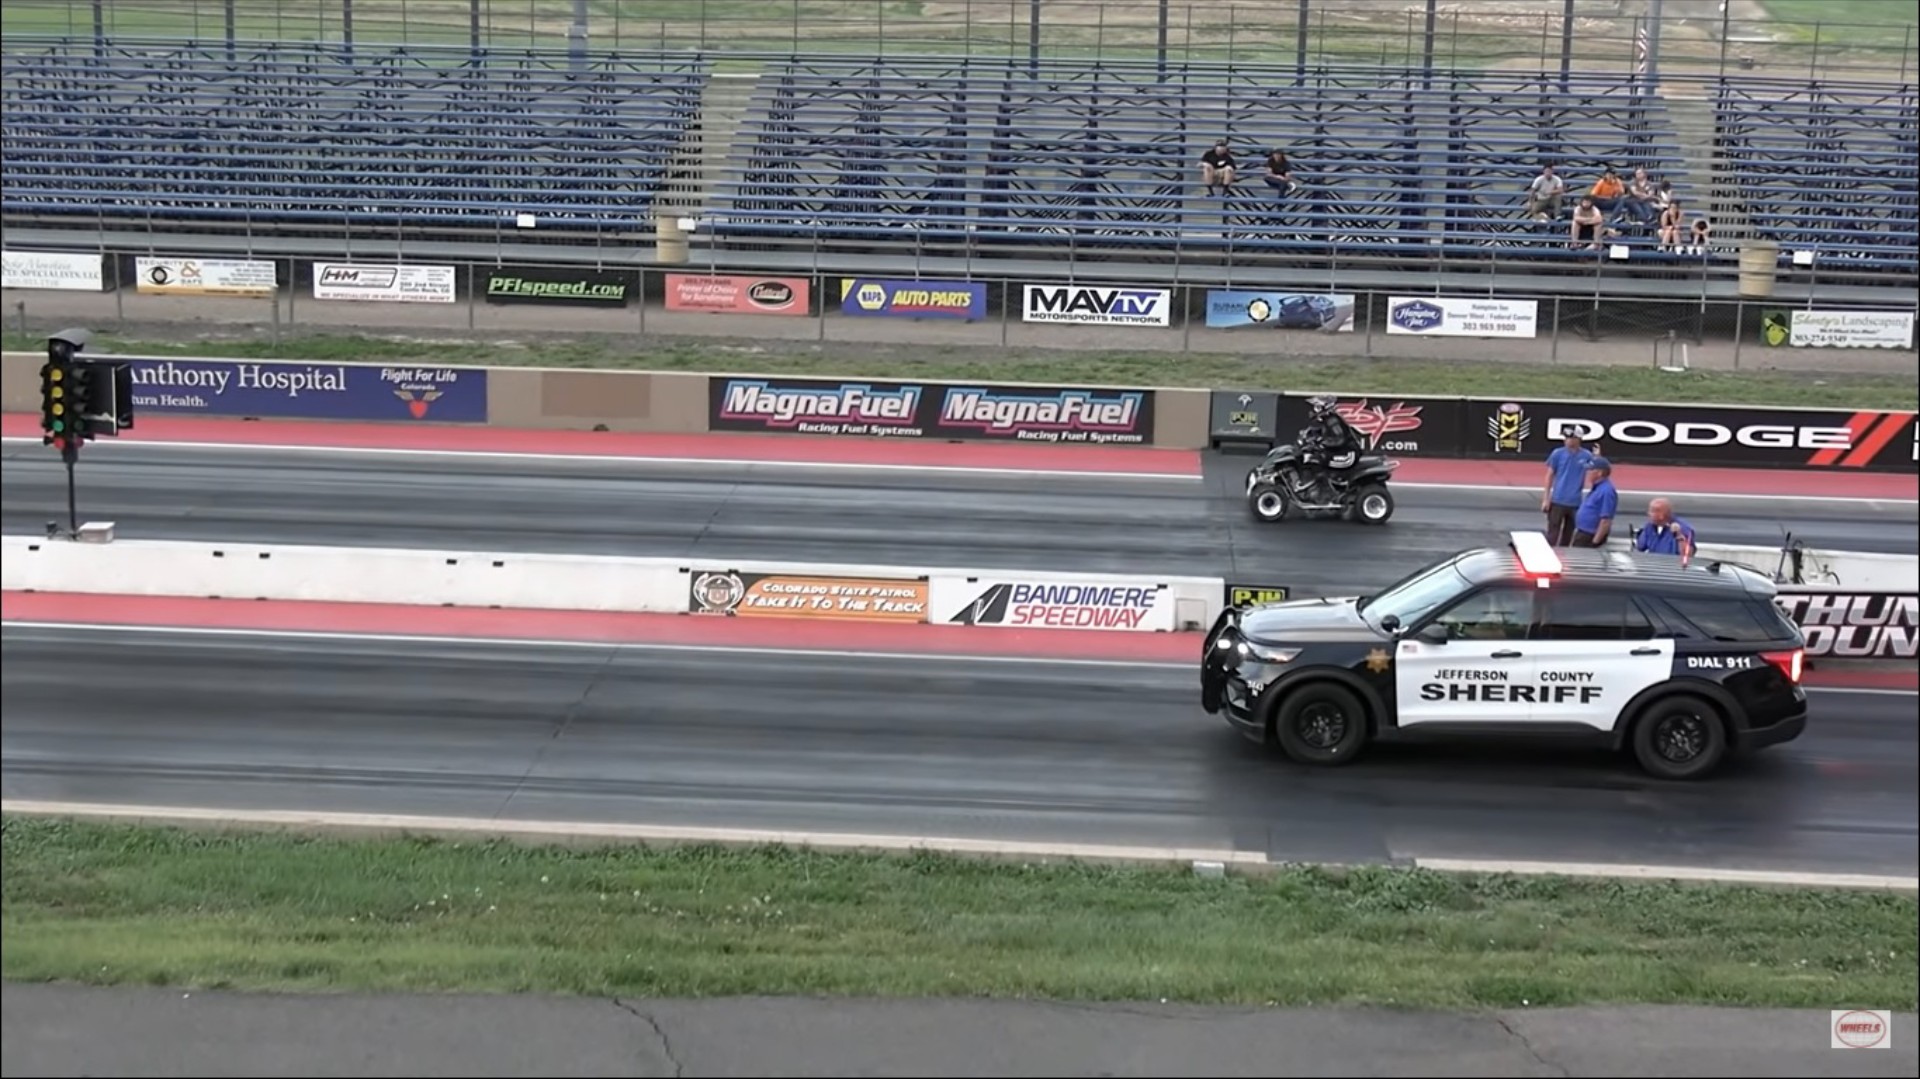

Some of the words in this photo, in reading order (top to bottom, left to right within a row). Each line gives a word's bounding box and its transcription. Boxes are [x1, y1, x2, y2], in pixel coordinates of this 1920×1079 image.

[892, 290, 929, 305] AUTO
[930, 291, 972, 307] PARTS
[1029, 287, 1162, 315] MAVTV
[1030, 312, 1109, 322] MOTORSPORTS
[1111, 315, 1162, 324] NETWORK
[1842, 316, 1909, 329] Landscaping
[237, 365, 347, 397] Hospital
[381, 368, 413, 384] Flight
[415, 369, 434, 381] For
[435, 370, 458, 382] Life
[726, 384, 915, 421] MagnaFuel
[945, 391, 1135, 428] MagnaFuel
[798, 423, 839, 434] Racing
[841, 424, 867, 434] Fuel
[870, 425, 923, 437] Systems
[1017, 430, 1058, 442] Racing
[1060, 431, 1087, 442] Fuel
[1090, 432, 1143, 444] Systems
[1547, 417, 1852, 450] DODGE
[762, 583, 828, 595] COLORADO
[831, 586, 867, 596] STATE
[869, 587, 917, 598] PATROL
[1012, 583, 1158, 608] BANDIMERE
[746, 594, 789, 607] TAKE
[811, 596, 833, 609] TO
[839, 597, 869, 611] THE
[873, 599, 924, 612] TRACK
[1011, 605, 1148, 628] SPEEDWAY
[1687, 656, 1723, 668] DIAL
[1726, 656, 1751, 669] 911
[1434, 669, 1508, 681] JEFFERSON
[1540, 671, 1594, 682] COUNTY
[1420, 682, 1603, 704] SHERIFF
